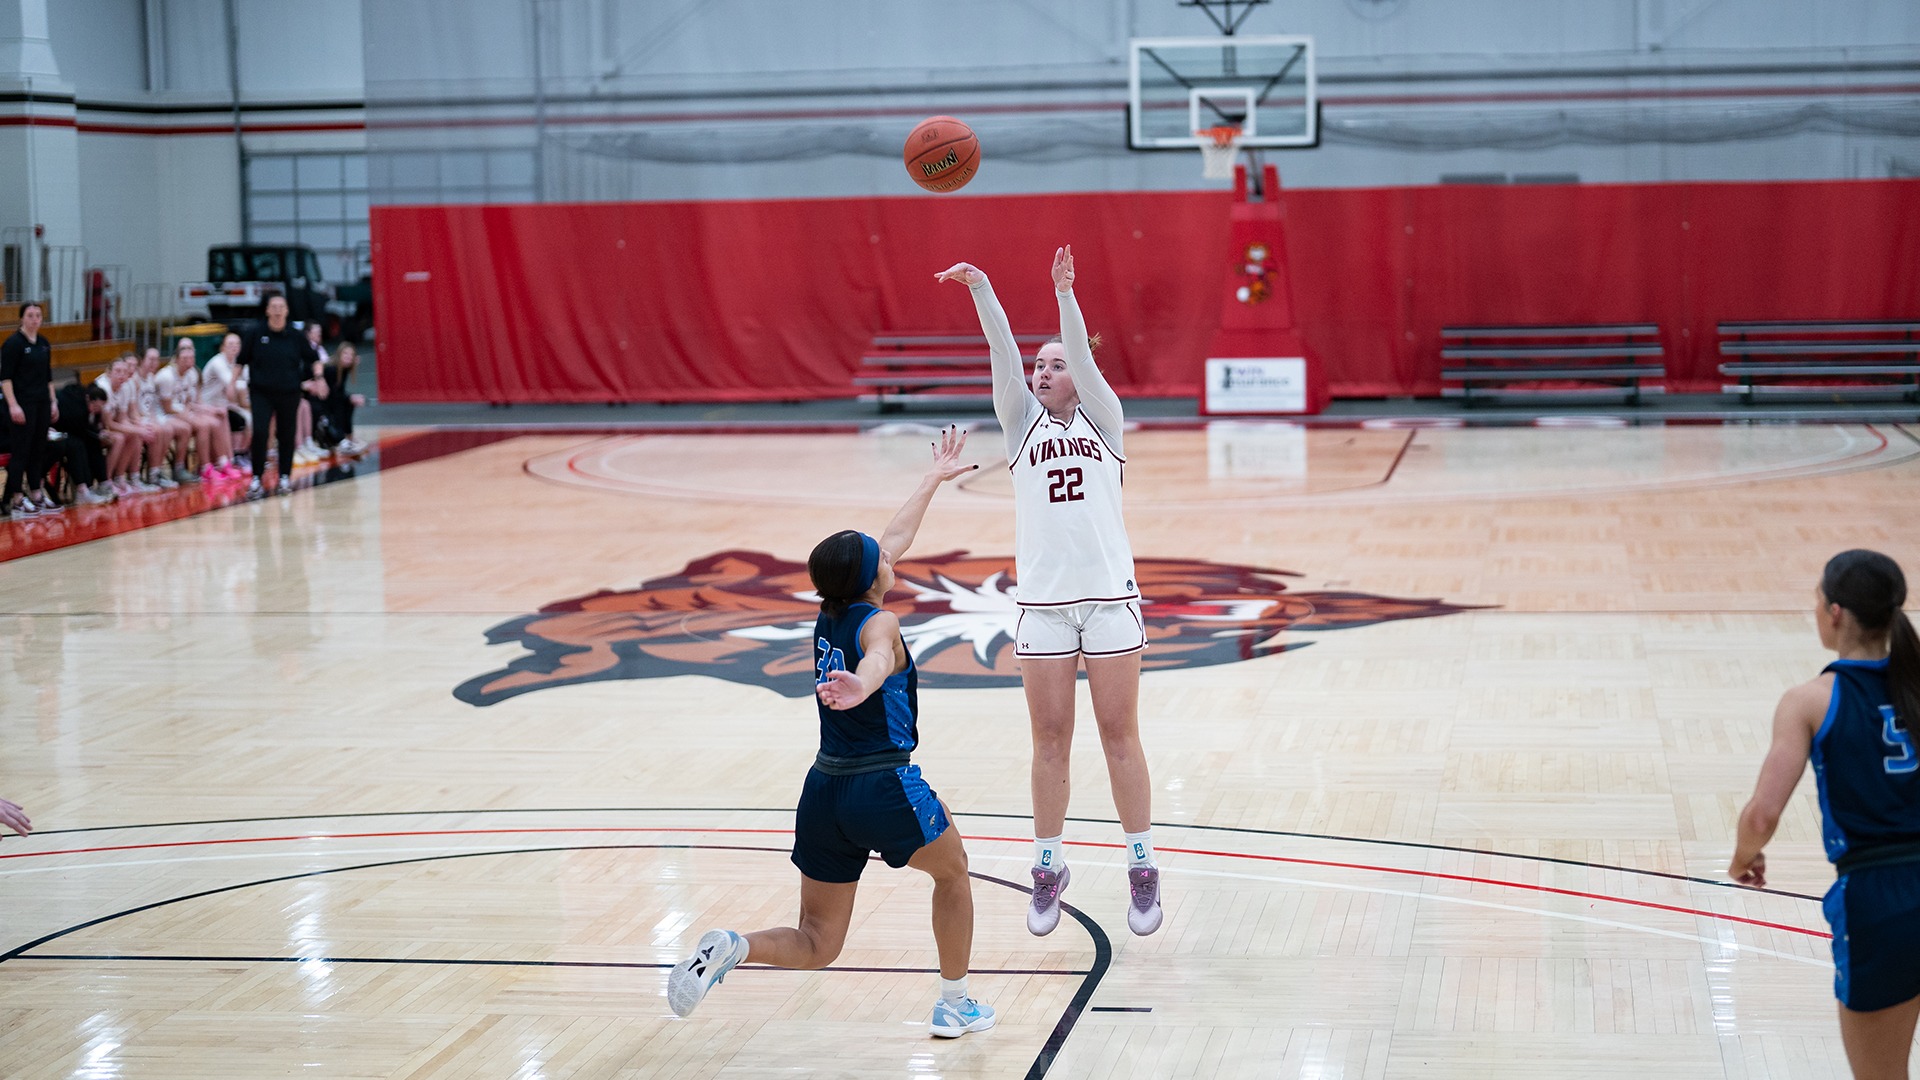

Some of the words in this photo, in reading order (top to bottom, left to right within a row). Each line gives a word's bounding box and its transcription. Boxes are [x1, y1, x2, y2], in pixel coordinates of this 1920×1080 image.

[1029, 437, 1103, 467] VIKINGS
[1047, 467, 1084, 503] 22
[1878, 704, 1920, 774] 5
